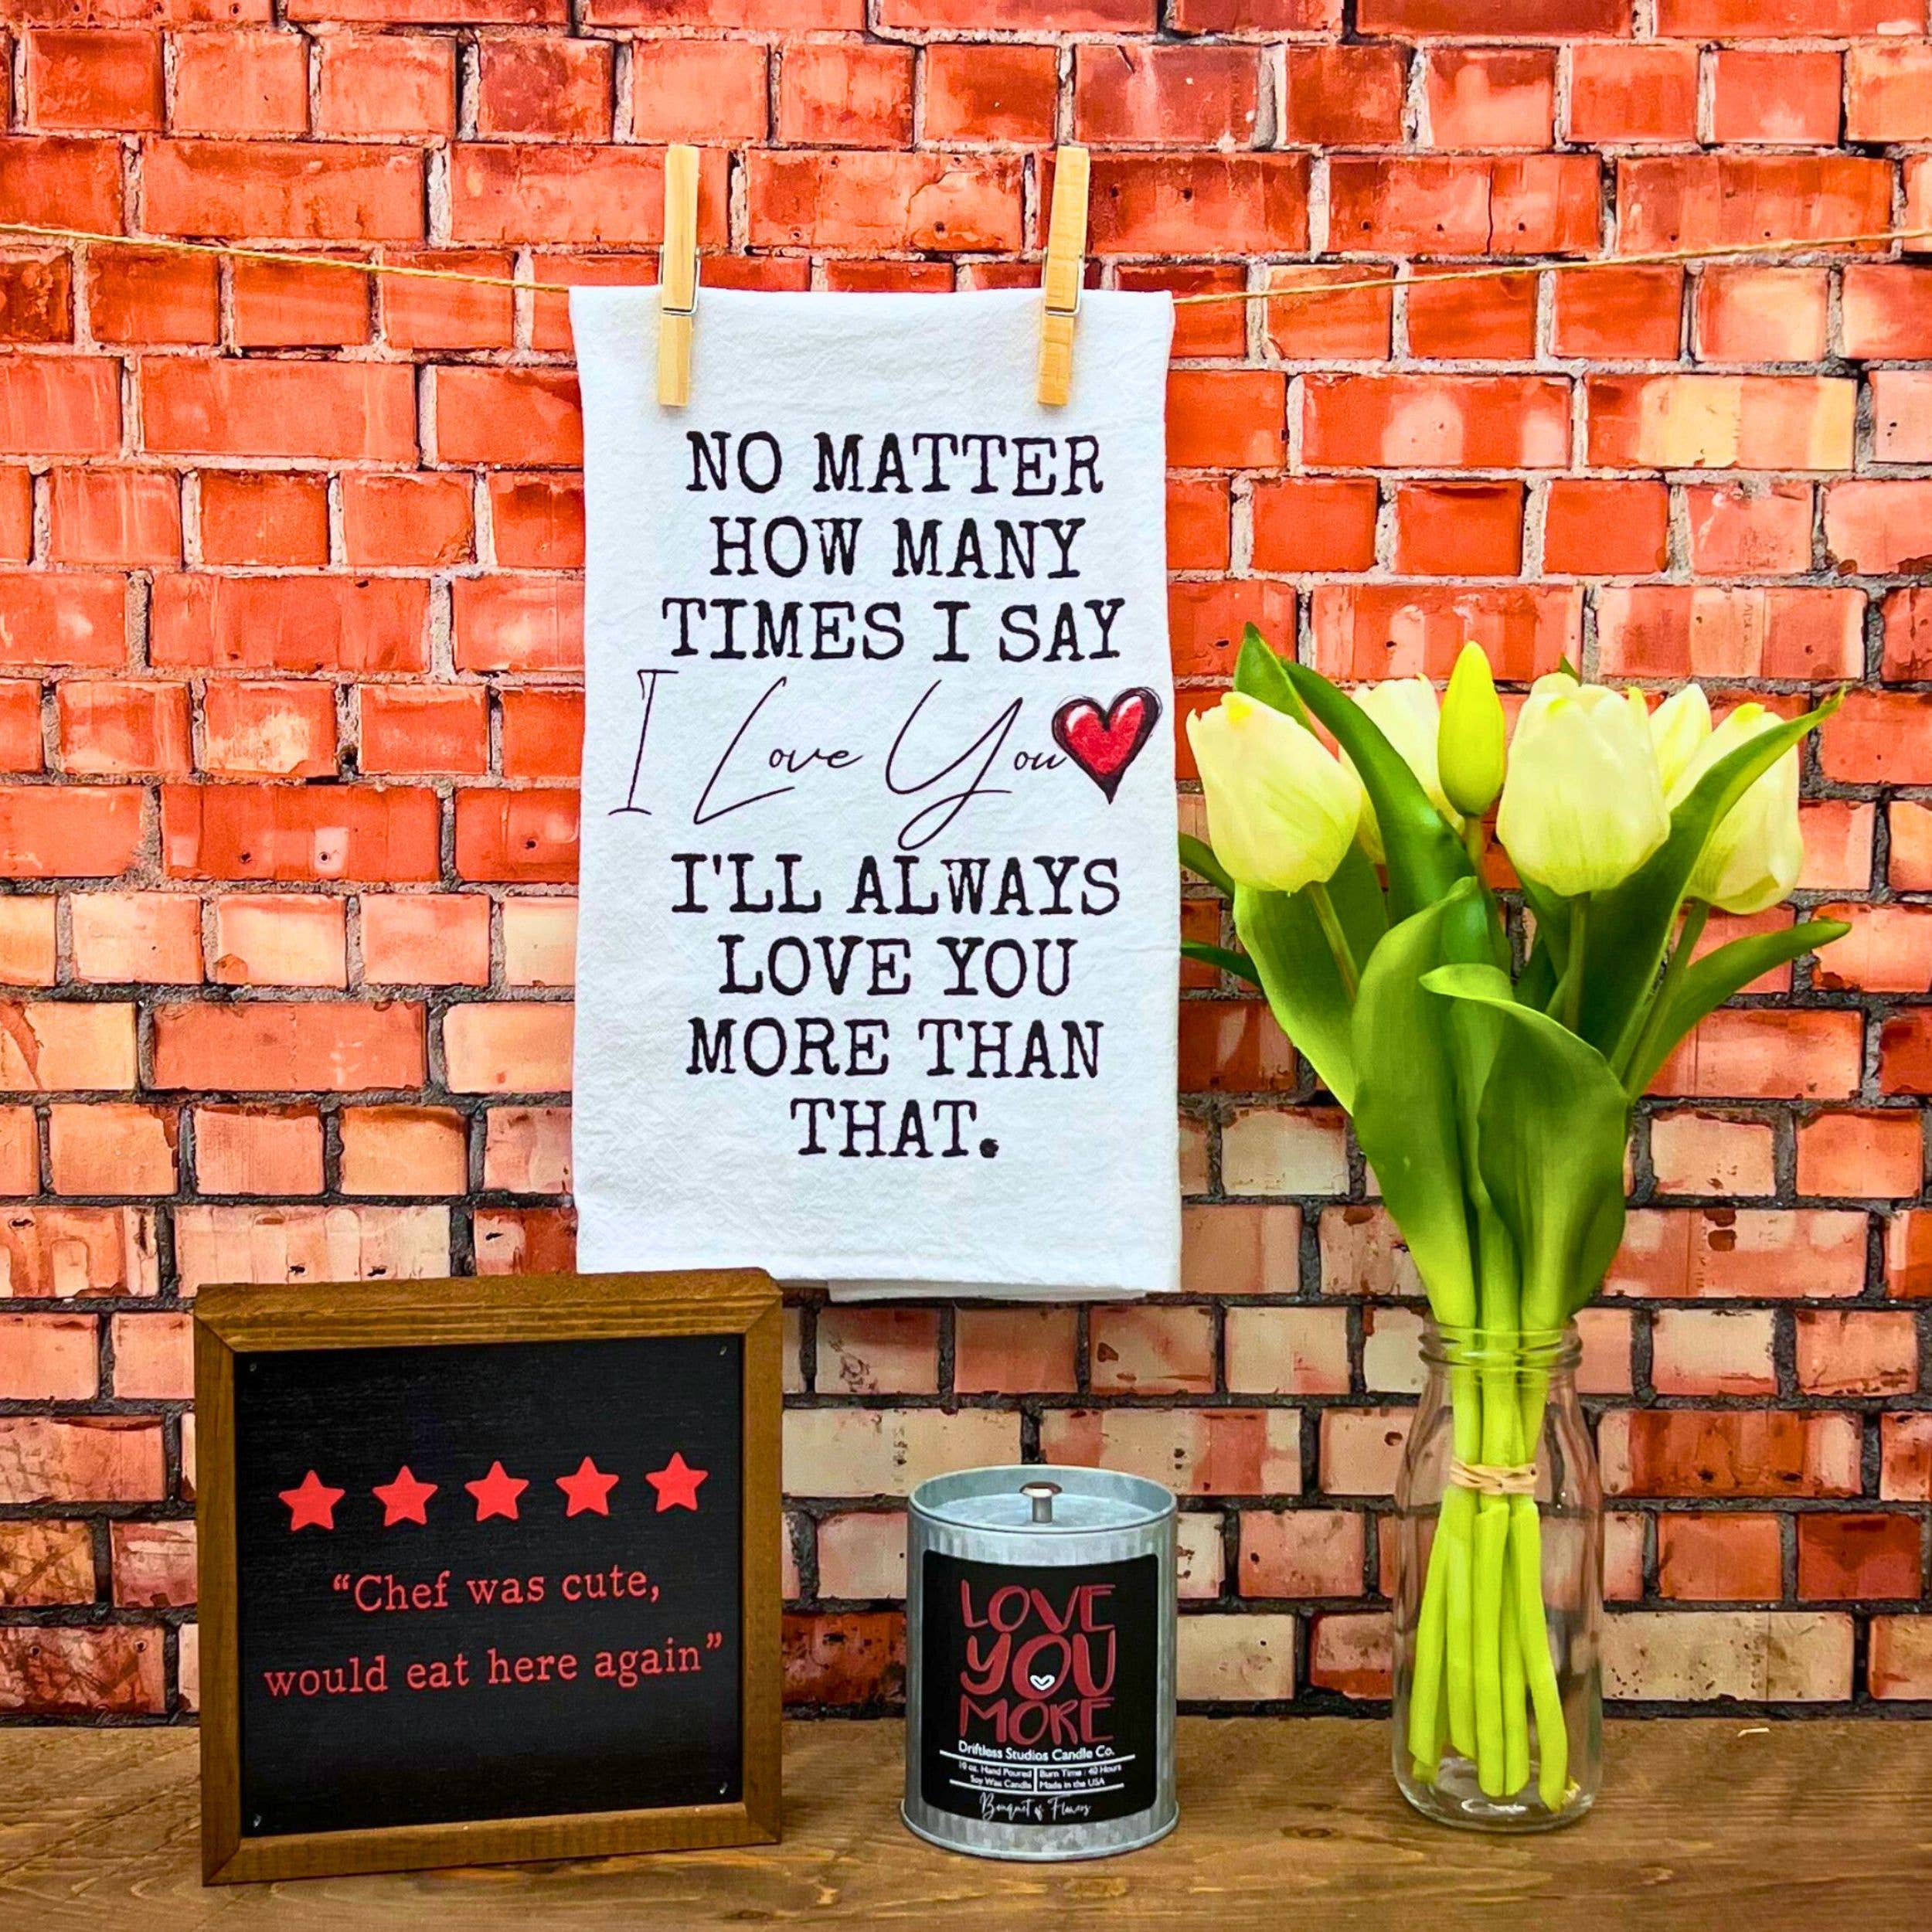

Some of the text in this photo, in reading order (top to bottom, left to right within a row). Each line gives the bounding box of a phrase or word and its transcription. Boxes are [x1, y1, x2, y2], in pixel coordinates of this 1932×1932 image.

[686, 430, 1104, 496] NO MATTER
[709, 516, 1086, 579] HOW MANY
[662, 597, 1125, 662] TIMES I SAY
[608, 669, 1070, 850] I Love You
[671, 853, 1121, 916] I'LL ALWAYS
[717, 934, 1078, 998] LOVE YOU
[686, 1017, 1104, 1079] MORE THAN
[790, 1097, 999, 1158] THAT.
[332, 1565, 661, 1613] “Chef was cute,
[961, 1579, 1117, 1634] LOVE
[264, 1631, 723, 1697] would eat here again”
[960, 1629, 1117, 1700] YOU
[958, 1740, 1115, 1761] Driftless Studios Candle Co.
[959, 1695, 1115, 1746] MORE
[1003, 1767, 1032, 1777] Poured
[1039, 1769, 1060, 1778] Burn
[1088, 1777, 1105, 1787] USA
